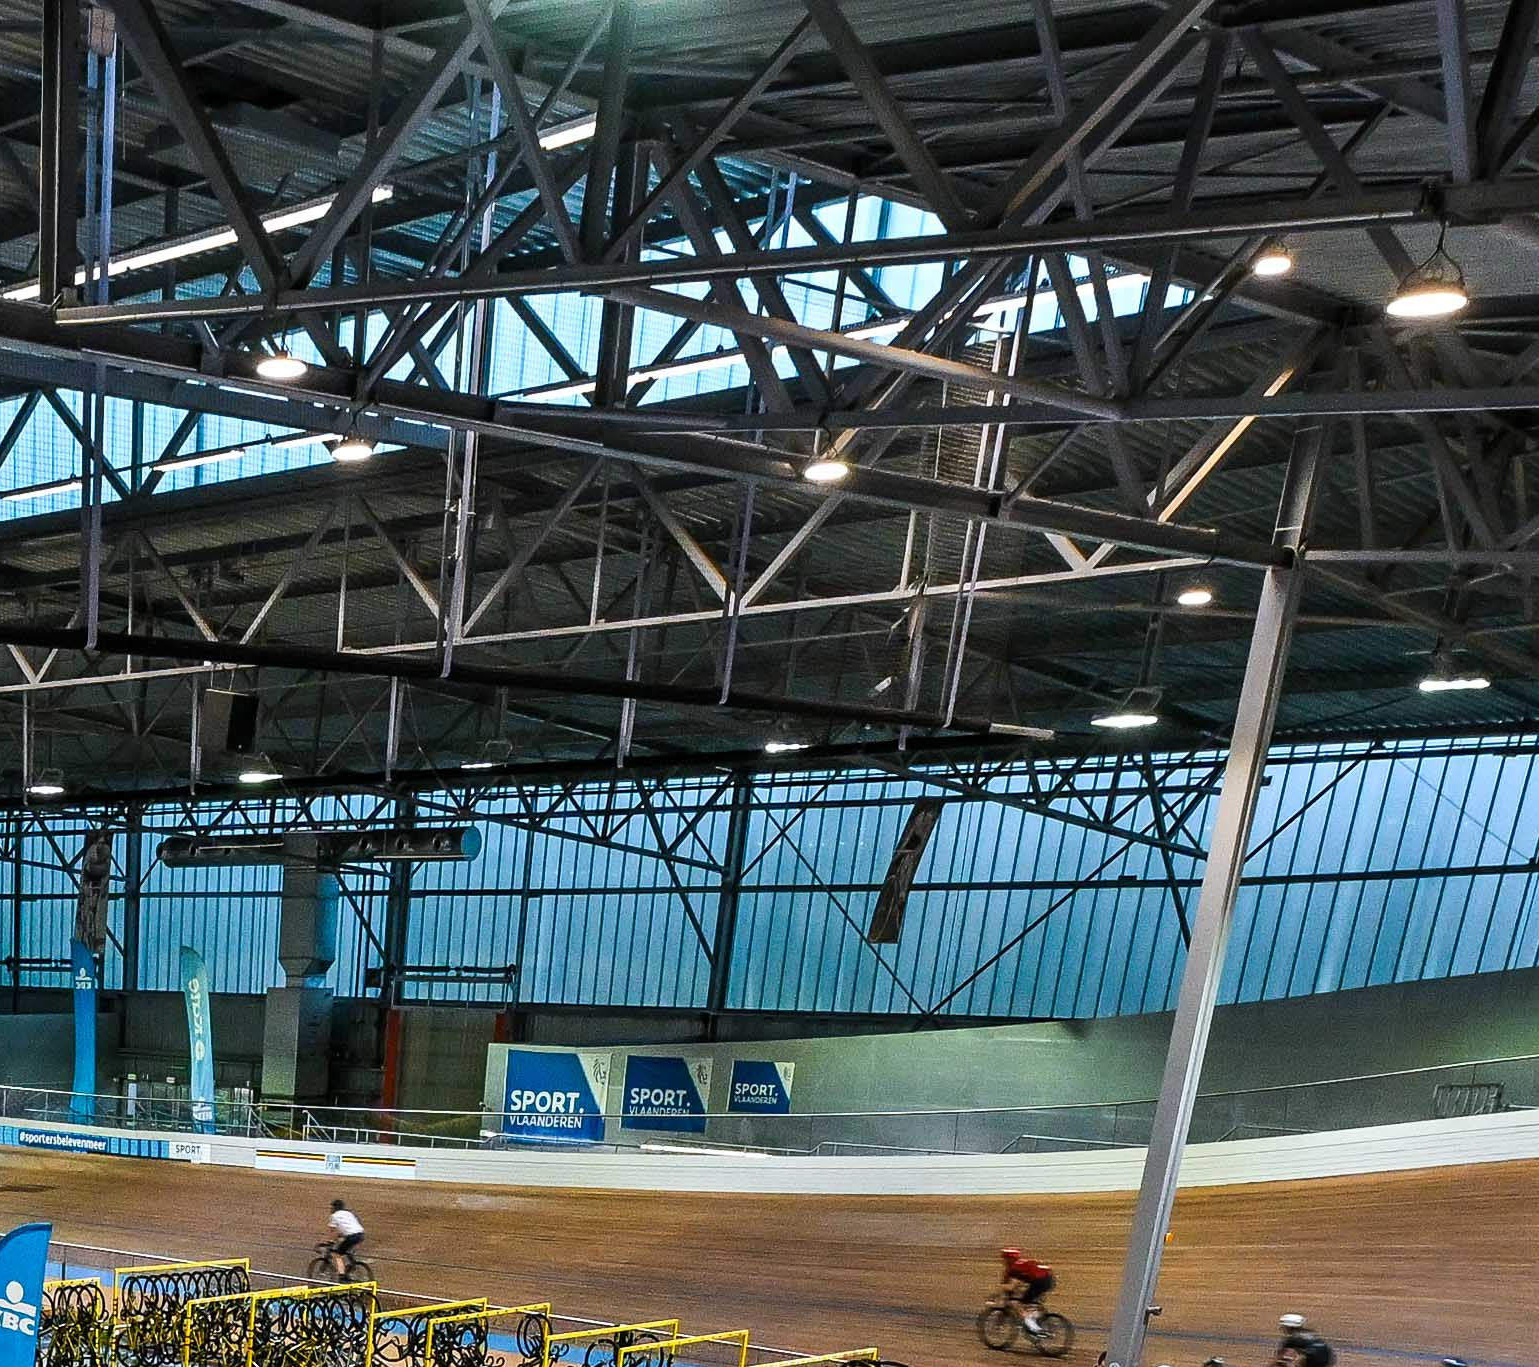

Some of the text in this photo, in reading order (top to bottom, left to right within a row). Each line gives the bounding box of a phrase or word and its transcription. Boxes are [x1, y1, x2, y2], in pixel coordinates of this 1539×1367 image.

[630, 1088, 691, 1107] SPORT.
[735, 1083, 779, 1097] SPORT.
[509, 1090, 585, 1114] SPORT.
[629, 1105, 690, 1117] VLAANDEREN
[509, 1114, 583, 1129] VLAANDEREN
[18, 1131, 107, 1151] #sportersbelevenmeer
[175, 1144, 202, 1154] SPORT
